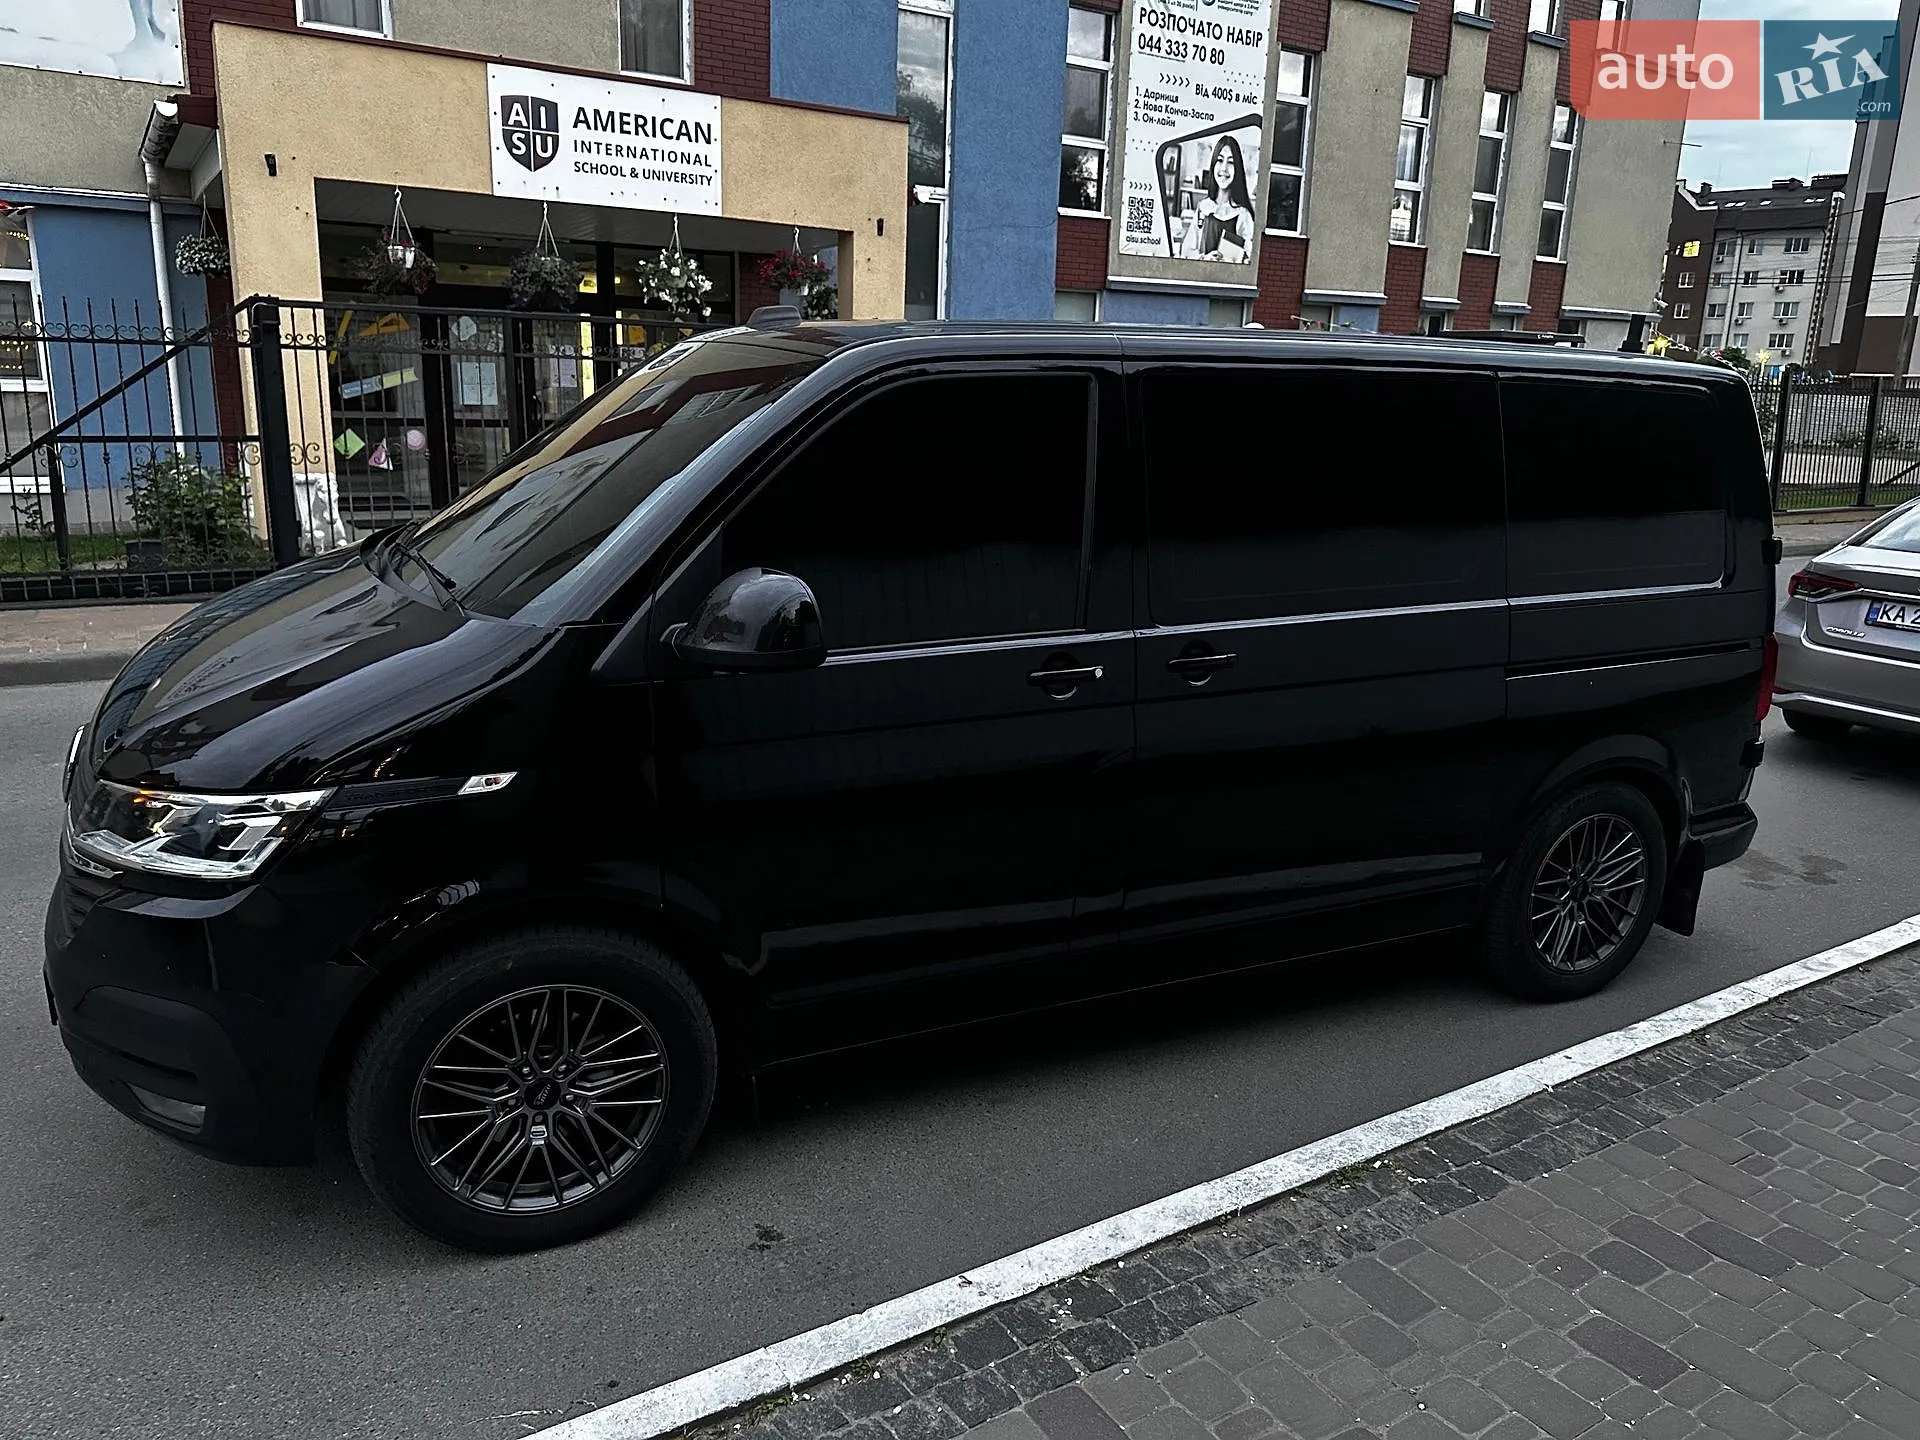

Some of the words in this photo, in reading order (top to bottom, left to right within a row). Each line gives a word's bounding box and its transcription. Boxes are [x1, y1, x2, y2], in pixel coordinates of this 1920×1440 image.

[1139, 7, 1222, 40] РОЗПОЧАТО
[1227, 26, 1263, 48] НАБІР
[1138, 33, 1161, 54] 044
[1165, 39, 1188, 59] 333
[1192, 44, 1206, 62] 70
[1210, 48, 1225, 66] 80
[1135, 86, 1142, 97] 1.
[1143, 88, 1179, 104] Дарниця
[1195, 83, 1209, 98] Від
[1211, 86, 1233, 102] 400$
[1242, 91, 1258, 105] міс
[1133, 112, 1141, 122] 3.
[1142, 113, 1176, 128] Он-лайн
[1134, 100, 1142, 110] 2.
[1143, 101, 1162, 113] Нова
[1164, 104, 1215, 122] Конча-Заспа
[573, 106, 712, 145] AMERICAN
[573, 139, 712, 168] INTERNATIONAL
[573, 161, 627, 178] SCHOOL
[630, 167, 639, 179] &
[642, 169, 713, 187] UNIVERSITY
[1880, 603, 1906, 623] KA
